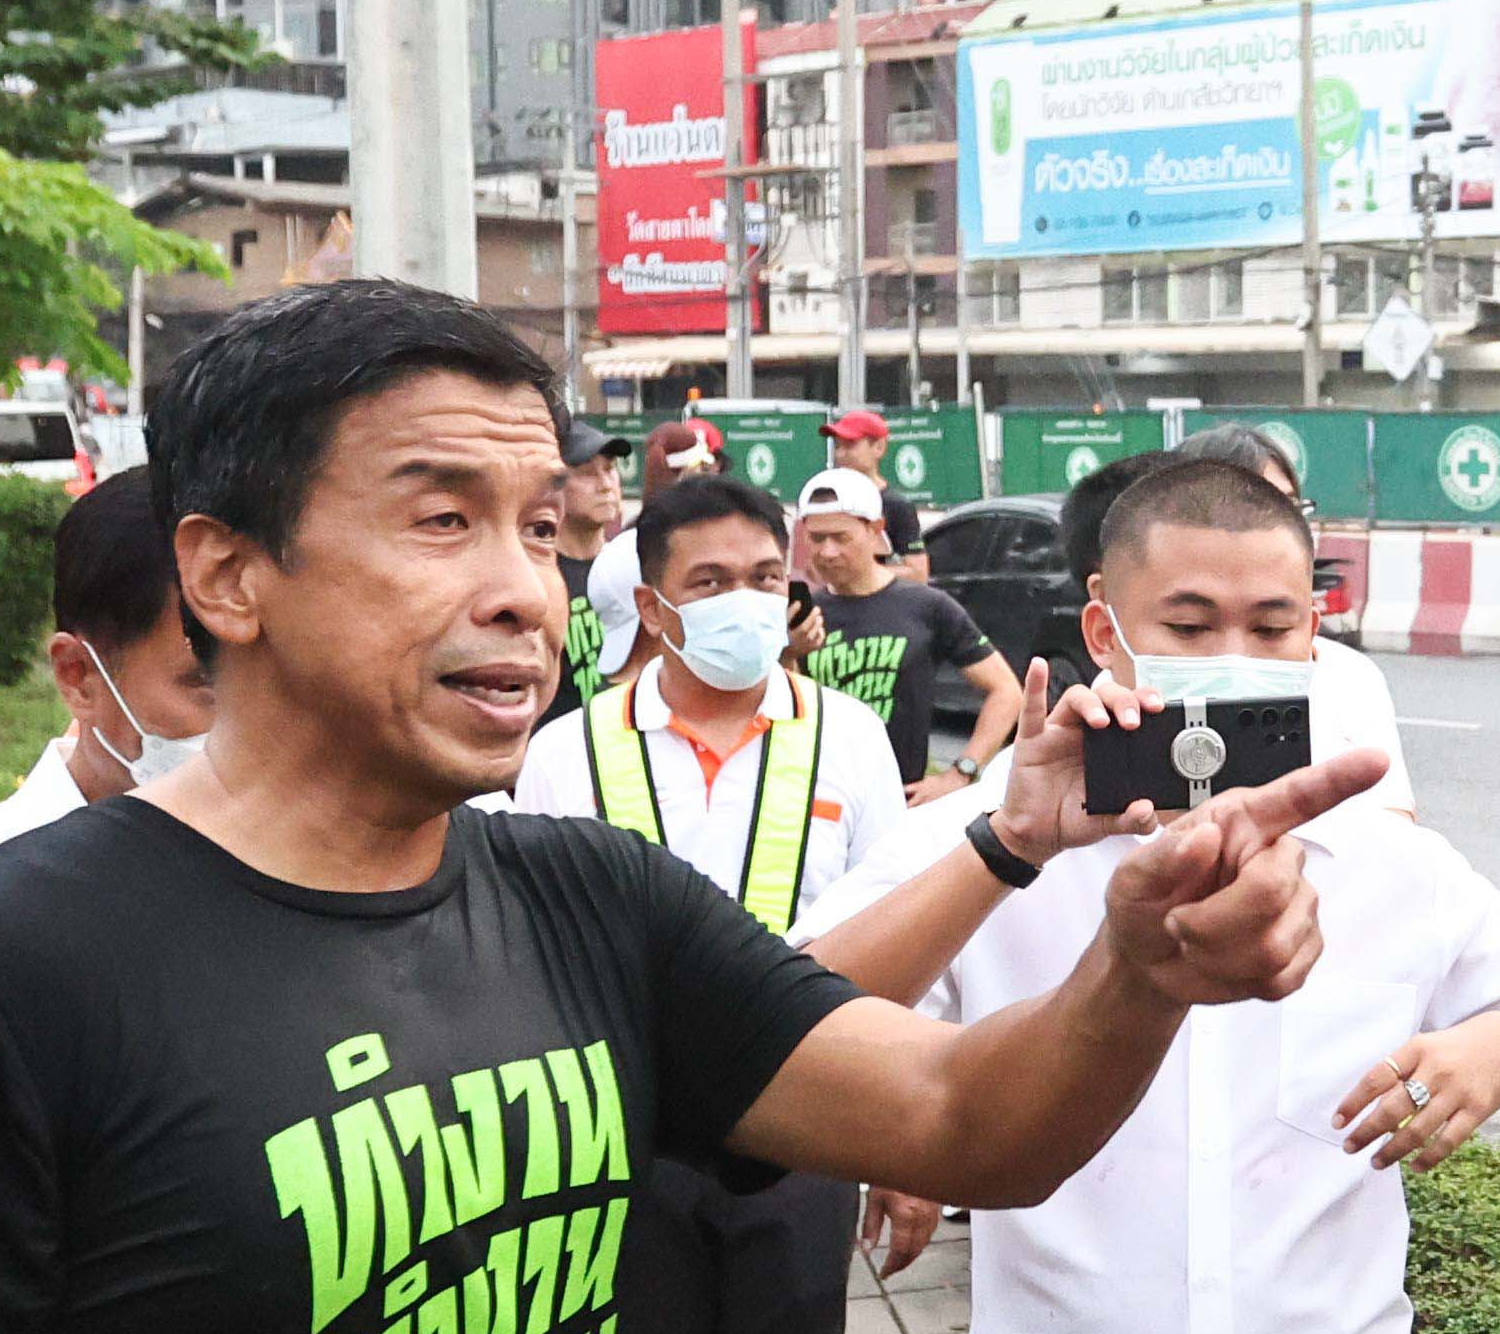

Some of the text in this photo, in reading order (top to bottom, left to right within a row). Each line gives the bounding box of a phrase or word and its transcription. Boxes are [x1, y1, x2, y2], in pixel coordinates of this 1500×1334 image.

[1041, 19, 1426, 86] ผ่านงานวิจัยในกลุ่มผู้ป่วสะเก็ดเงิน
[605, 104, 726, 167] ร้านแว่นต
